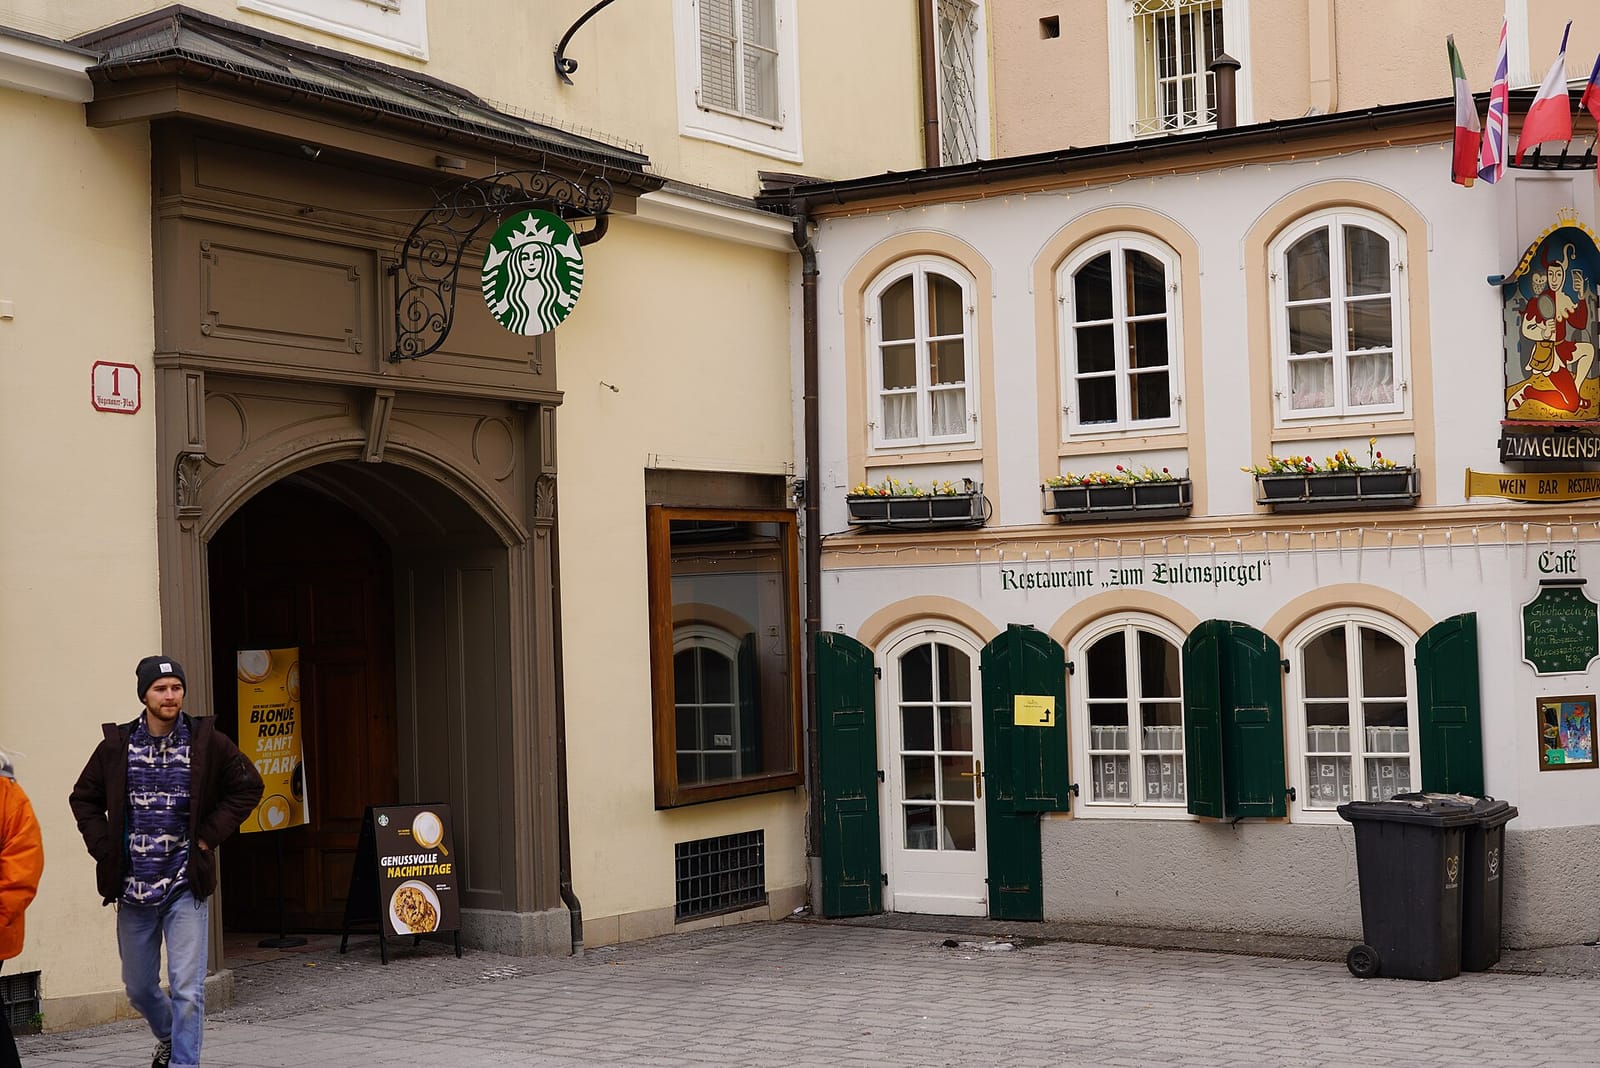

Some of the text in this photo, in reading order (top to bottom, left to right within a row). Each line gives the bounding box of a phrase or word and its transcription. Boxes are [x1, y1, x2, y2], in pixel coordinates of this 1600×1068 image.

[112, 368, 120, 396] 1
[1499, 479, 1526, 494] WEIN
[1538, 479, 1558, 494] BAR
[1538, 549, 1576, 574] Café
[1001, 568, 1094, 590] Restaurant
[250, 708, 294, 723] BLONDE
[258, 721, 295, 737] ROAST
[256, 736, 293, 752] SANFT
[254, 756, 296, 775] STARK
[381, 854, 437, 866] GENUSSVOLLE
[387, 863, 452, 878] NACHMITTAGE
